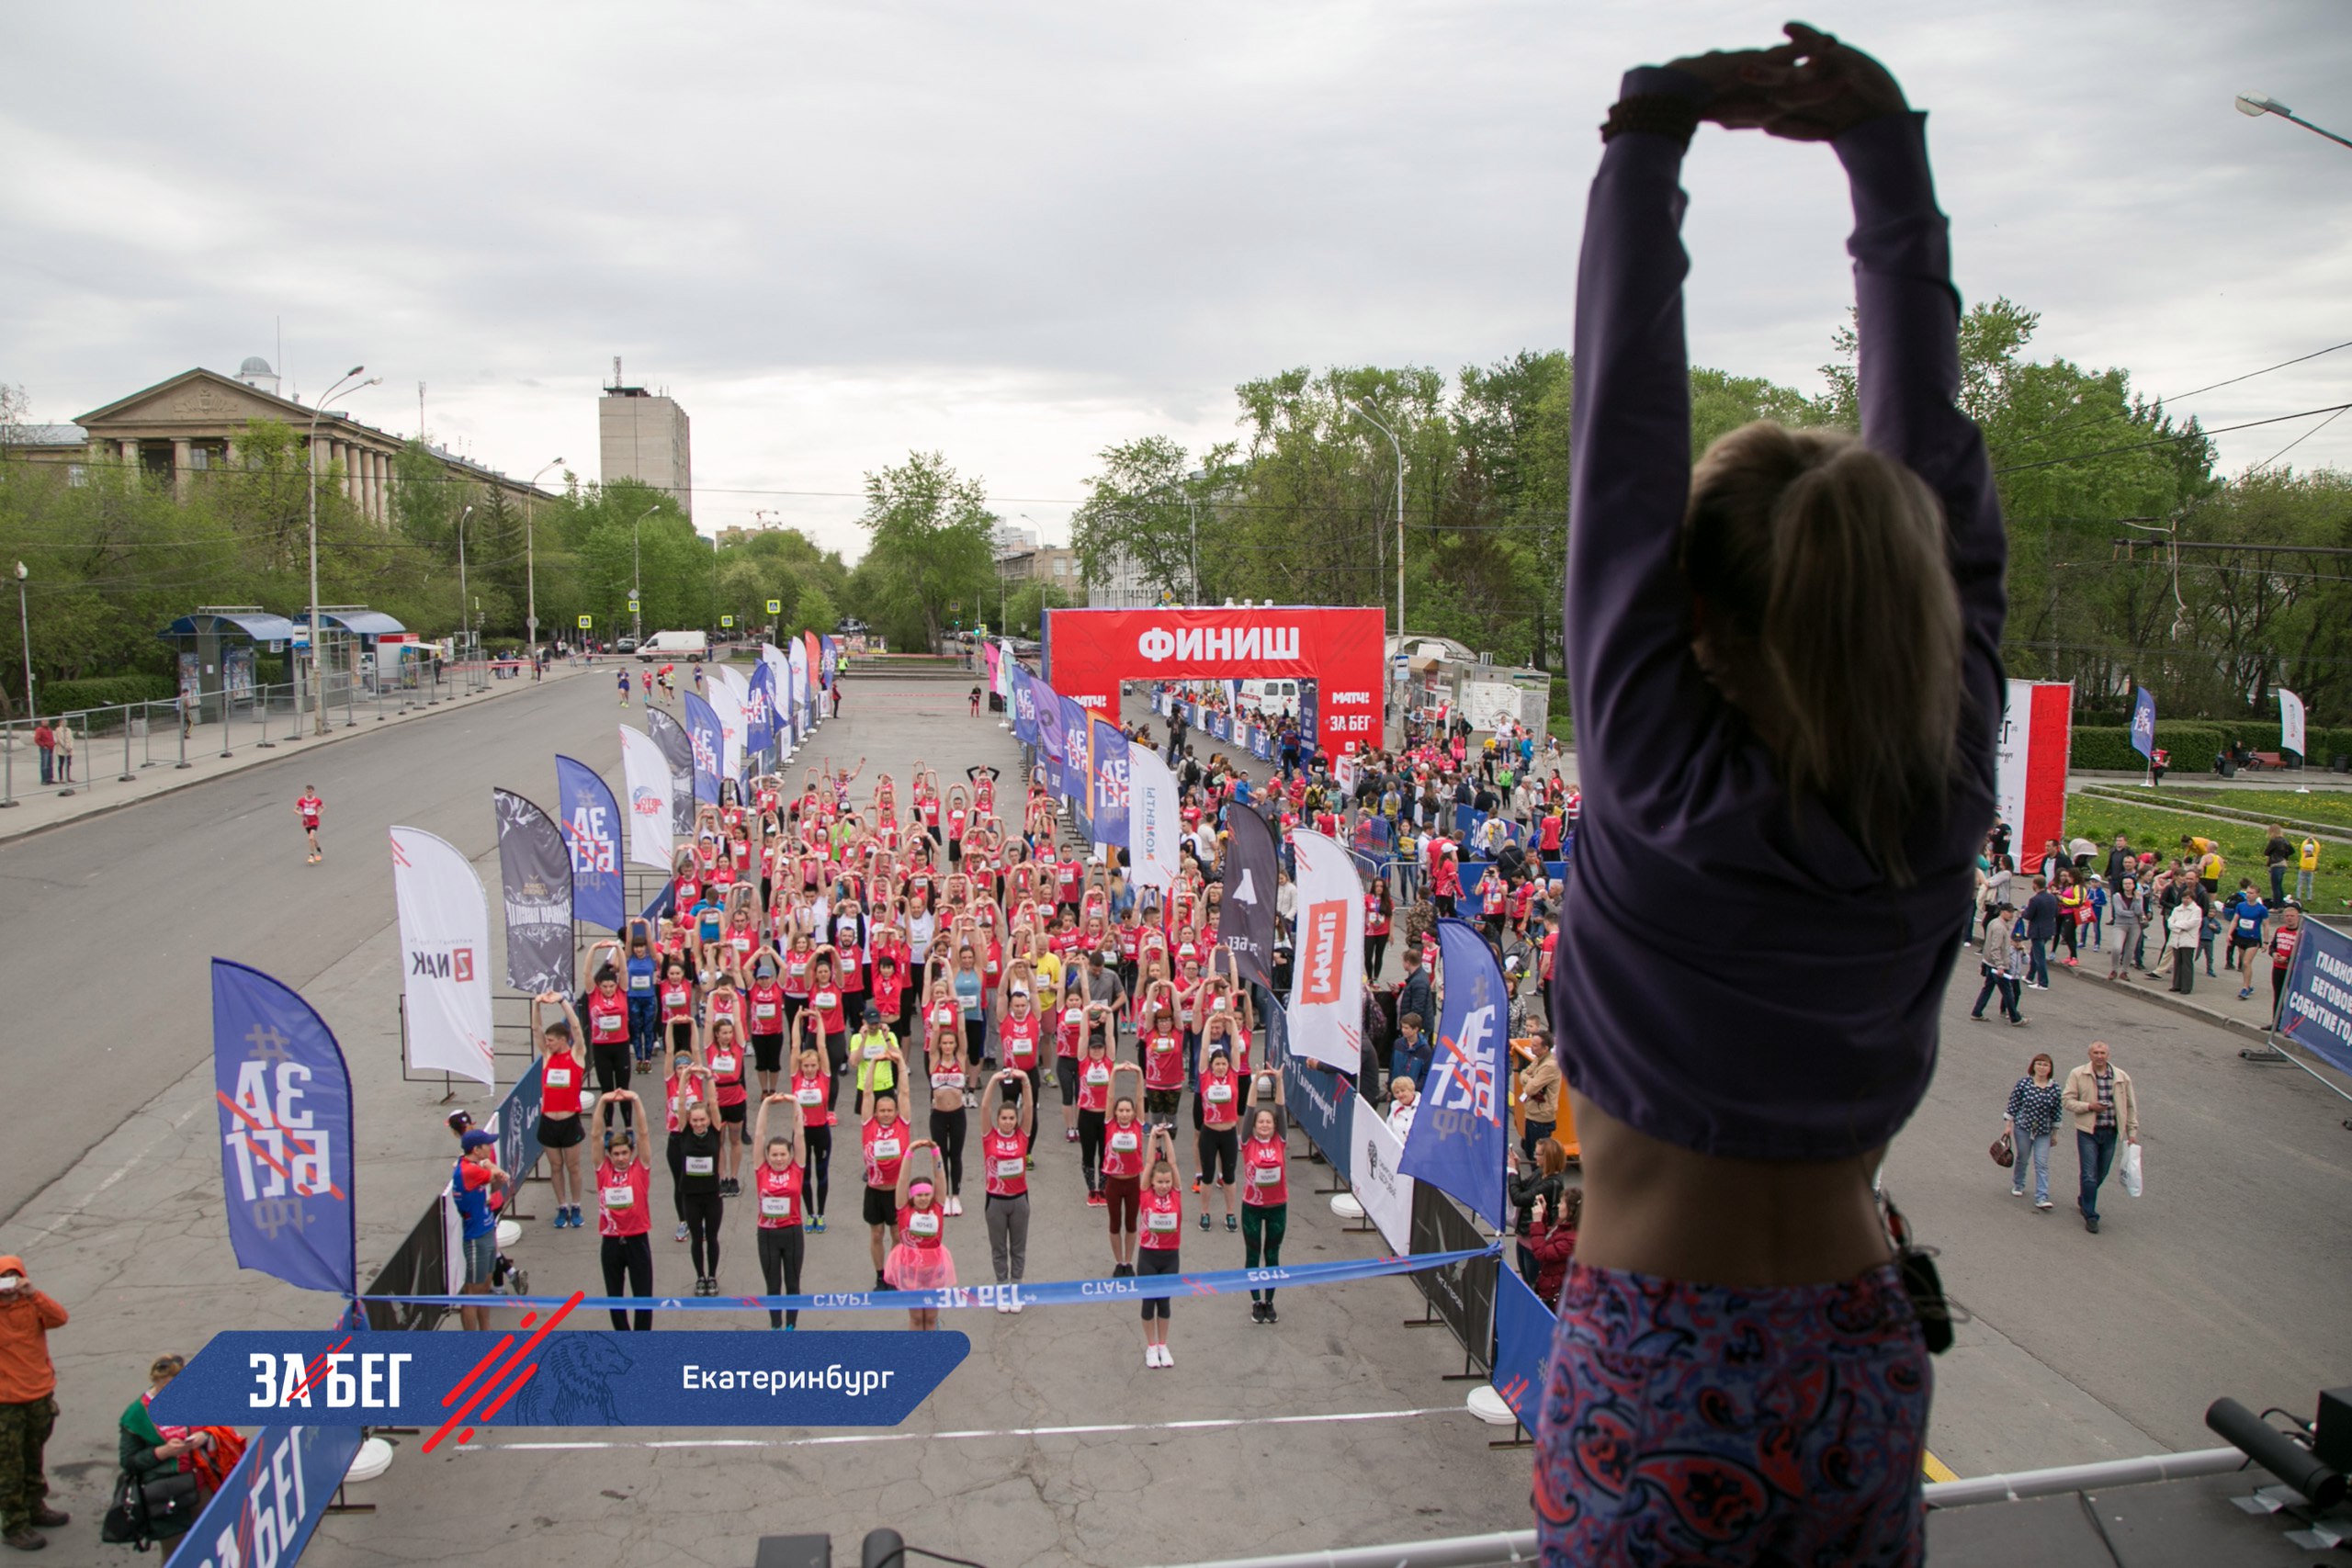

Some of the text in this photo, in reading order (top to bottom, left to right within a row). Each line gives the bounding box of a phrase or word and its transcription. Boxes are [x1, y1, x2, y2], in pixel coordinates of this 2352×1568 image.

[1138, 626, 1299, 662] ФИНИШ
[1332, 692, 1369, 704] МАТЧ!
[1330, 716, 1371, 731] ЗА БЕГ
[2315, 950, 2352, 987] ГЛАВНО
[2289, 990, 2335, 1034] СОБЫТИЕ
[249, 1426, 306, 1568] БЕГ
